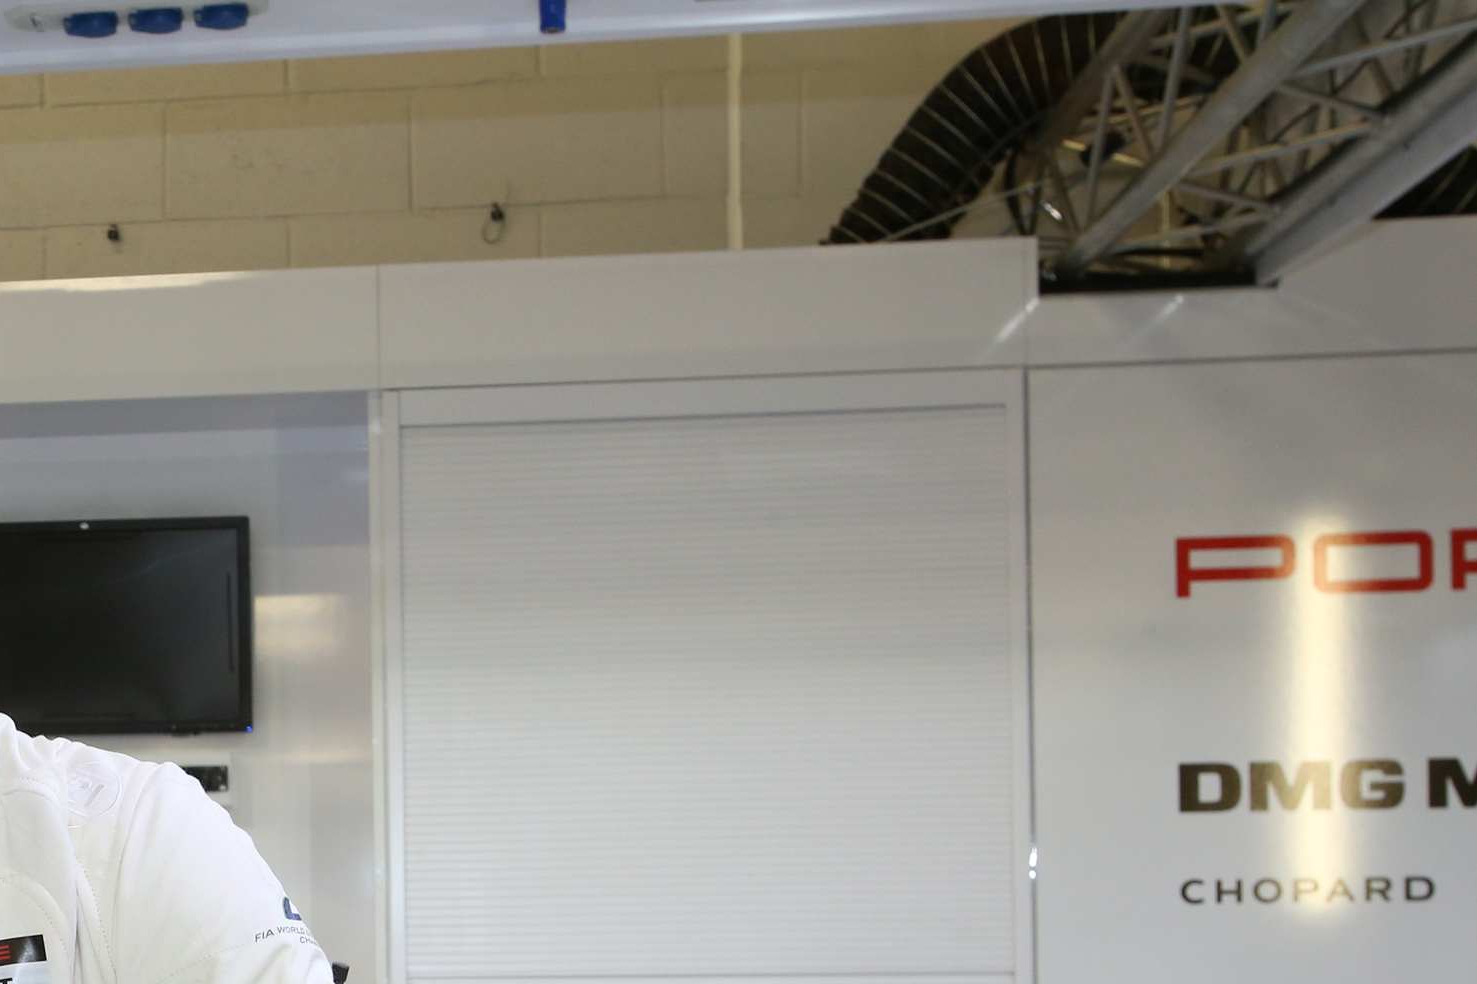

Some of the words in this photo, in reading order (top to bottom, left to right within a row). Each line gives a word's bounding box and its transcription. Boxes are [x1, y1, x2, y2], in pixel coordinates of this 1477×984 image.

[1175, 528, 1477, 599] PO
[1178, 758, 1406, 813] DMG
[1180, 876, 1436, 904] CHOPARD
[255, 928, 275, 942] FIA
